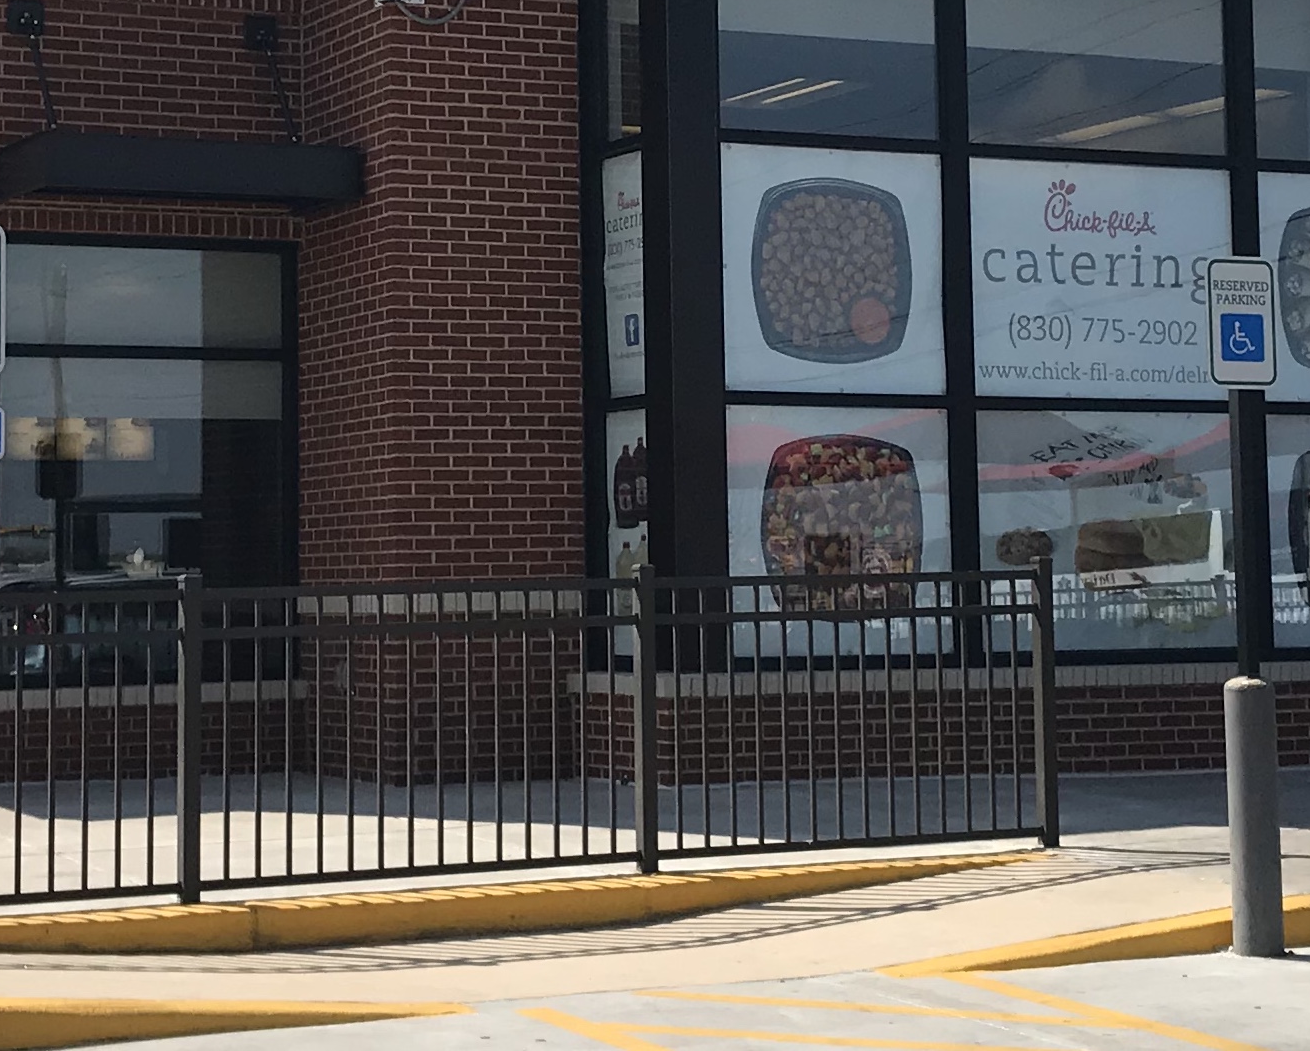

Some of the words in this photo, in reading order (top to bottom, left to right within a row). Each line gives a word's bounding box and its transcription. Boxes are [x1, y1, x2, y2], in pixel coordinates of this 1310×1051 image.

[1044, 191, 1157, 238] Chick-fil-A
[982, 243, 1209, 305] catering
[1212, 279, 1270, 293] RESERVED
[1216, 293, 1267, 307] PARKING
[1008, 312, 1072, 350] (830)
[1081, 317, 1198, 346] 775-2902
